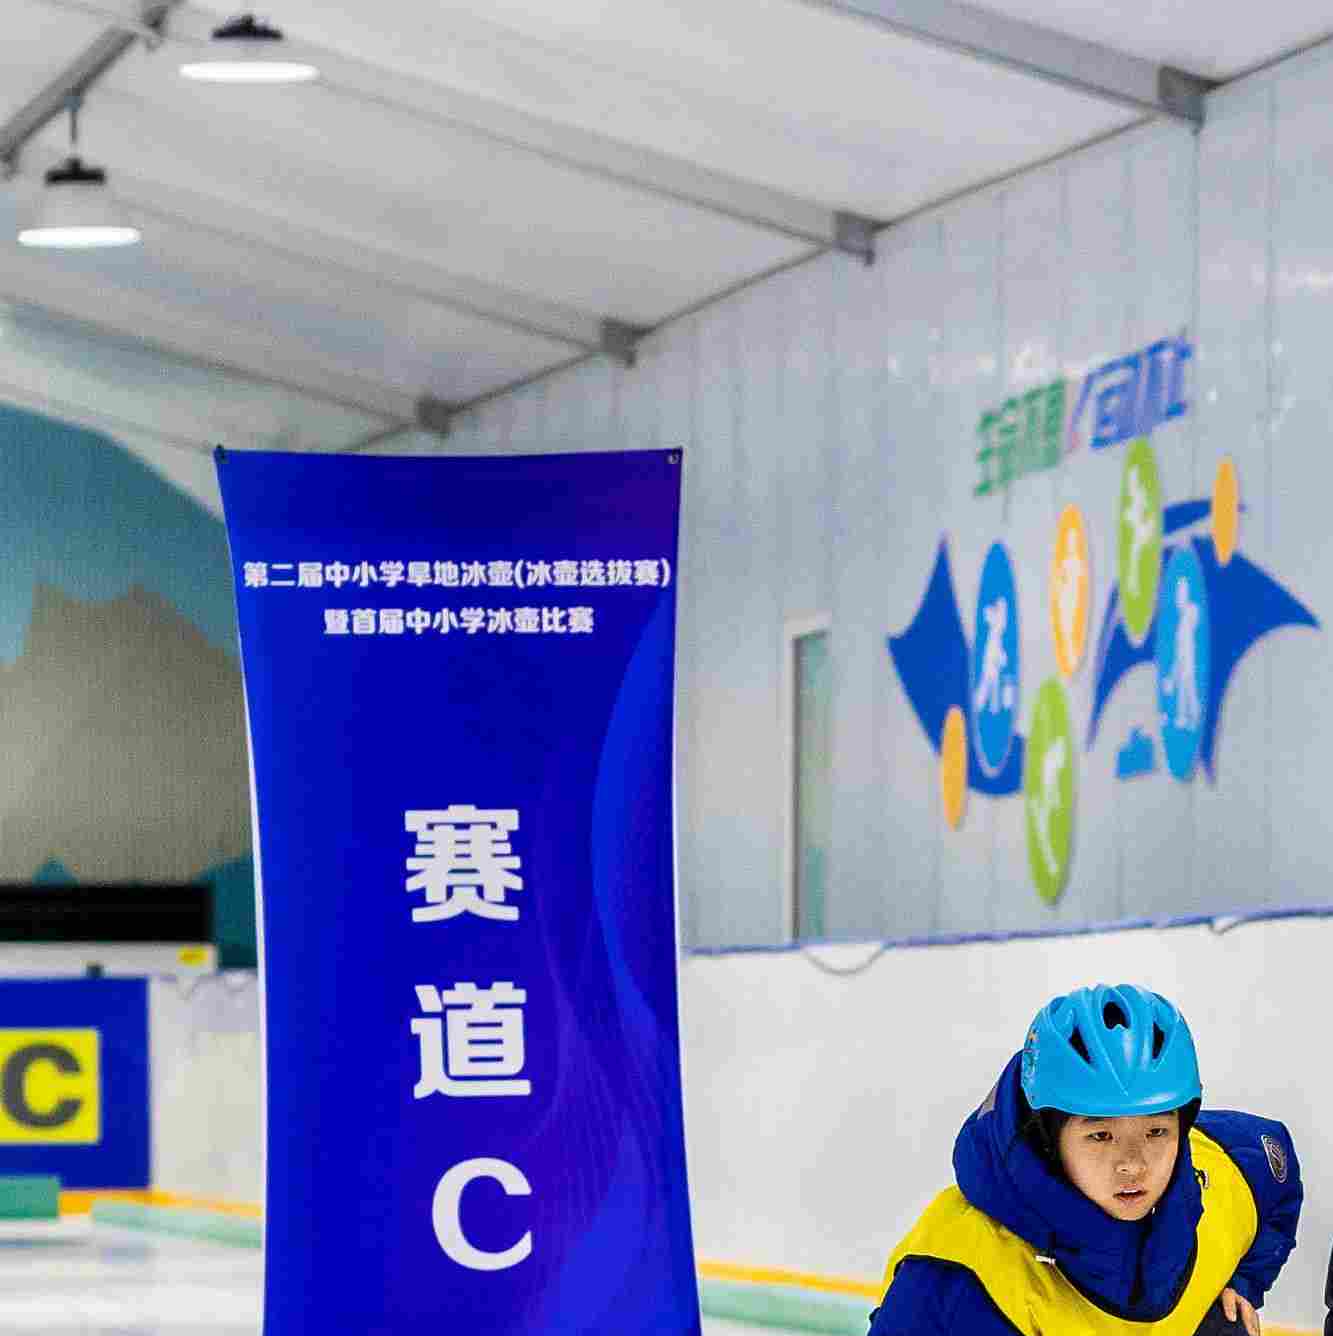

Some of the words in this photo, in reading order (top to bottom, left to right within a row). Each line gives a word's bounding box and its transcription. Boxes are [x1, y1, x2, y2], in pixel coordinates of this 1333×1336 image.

[323, 607, 594, 634] 暨首届中小学冰壶比赛
[1, 1044, 81, 1128] C
